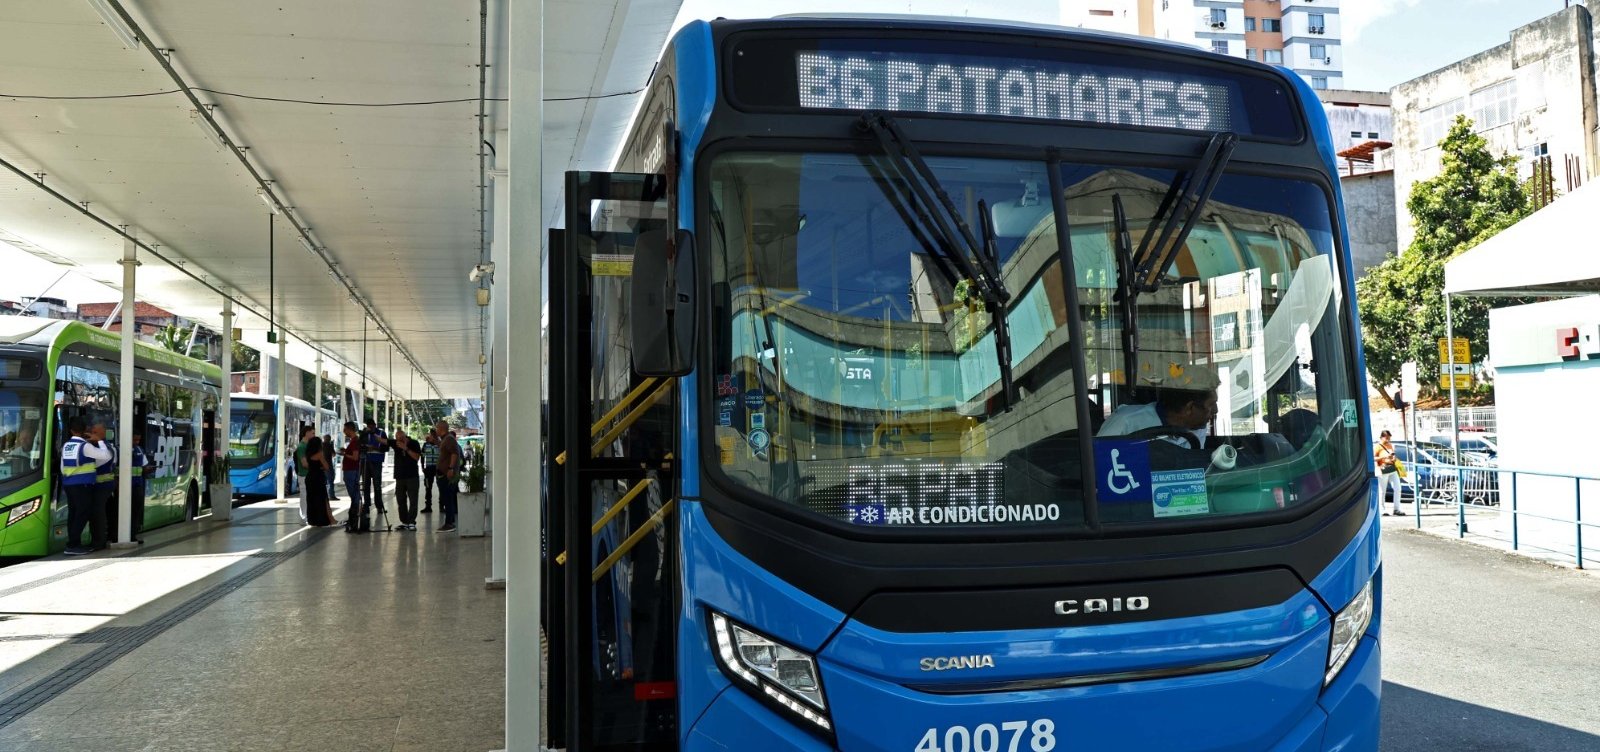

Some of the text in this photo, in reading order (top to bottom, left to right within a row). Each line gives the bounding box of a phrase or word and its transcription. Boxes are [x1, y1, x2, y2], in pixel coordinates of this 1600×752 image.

[800, 54, 1209, 131] B6 PATAMARES
[1344, 410, 1357, 423] G4
[888, 503, 1060, 524] AR CONDICIONADO
[1054, 596, 1150, 615] CAIO
[919, 654, 995, 671] SCANIA
[914, 718, 1056, 752] 40078
